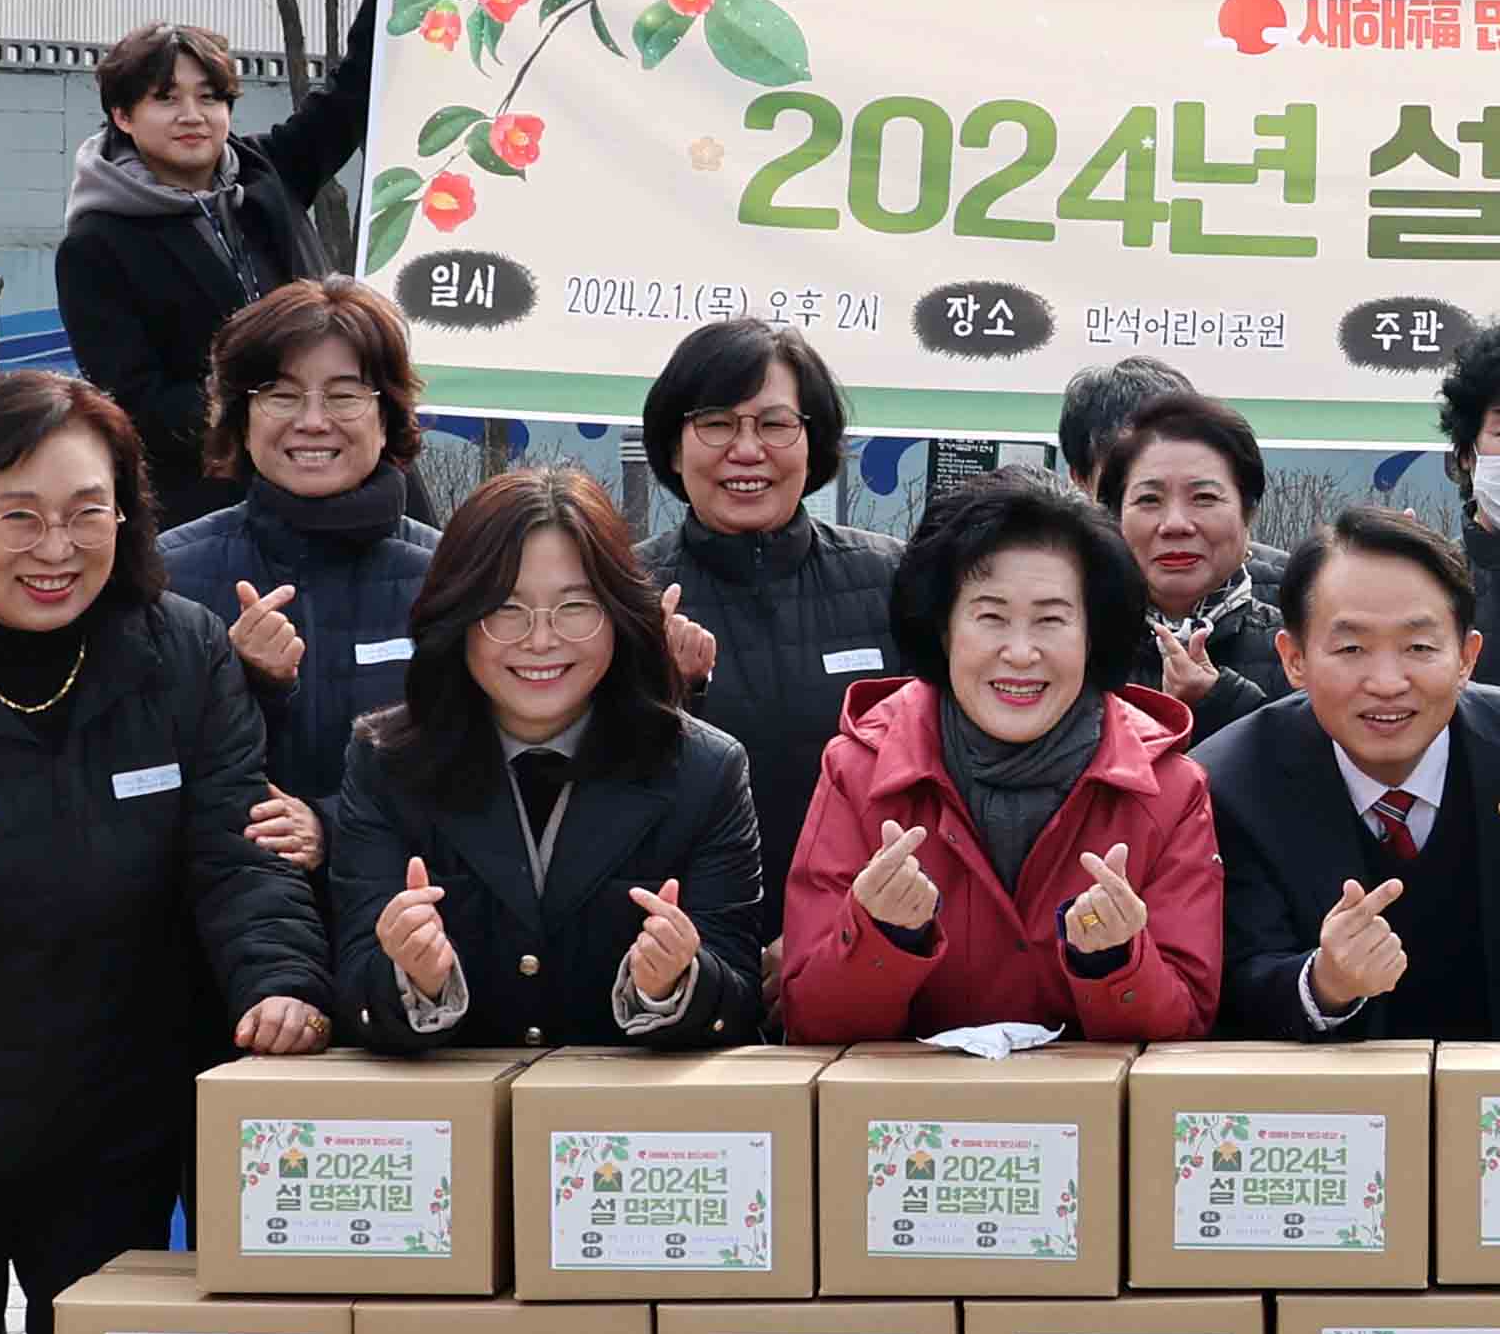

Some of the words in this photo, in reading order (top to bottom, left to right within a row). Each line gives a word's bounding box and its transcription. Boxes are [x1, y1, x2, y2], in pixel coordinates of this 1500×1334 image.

[738, 91, 1318, 258] 2024년
[429, 262, 496, 309] 일시
[567, 277, 748, 323] 2024.2.1.(목)
[769, 288, 822, 326] 오후
[837, 293, 882, 331] 2시
[946, 297, 1015, 338] 장소
[1086, 305, 1286, 349] 만석어린이공원
[1371, 311, 1444, 353] 주관
[316, 1155, 412, 1180] 2024년
[943, 1157, 1039, 1183] 2024년
[1250, 1148, 1346, 1174] 2024년
[630, 1168, 728, 1194] 2024년
[1210, 1177, 1235, 1204] 설
[1243, 1178, 1346, 1205] 명절지원
[277, 1184, 301, 1210] 설
[310, 1184, 412, 1211] 명절지원
[590, 1198, 616, 1224] 설
[624, 1198, 727, 1224] 명절지원
[903, 1185, 928, 1212] 설
[937, 1186, 1039, 1214] 명절지원
